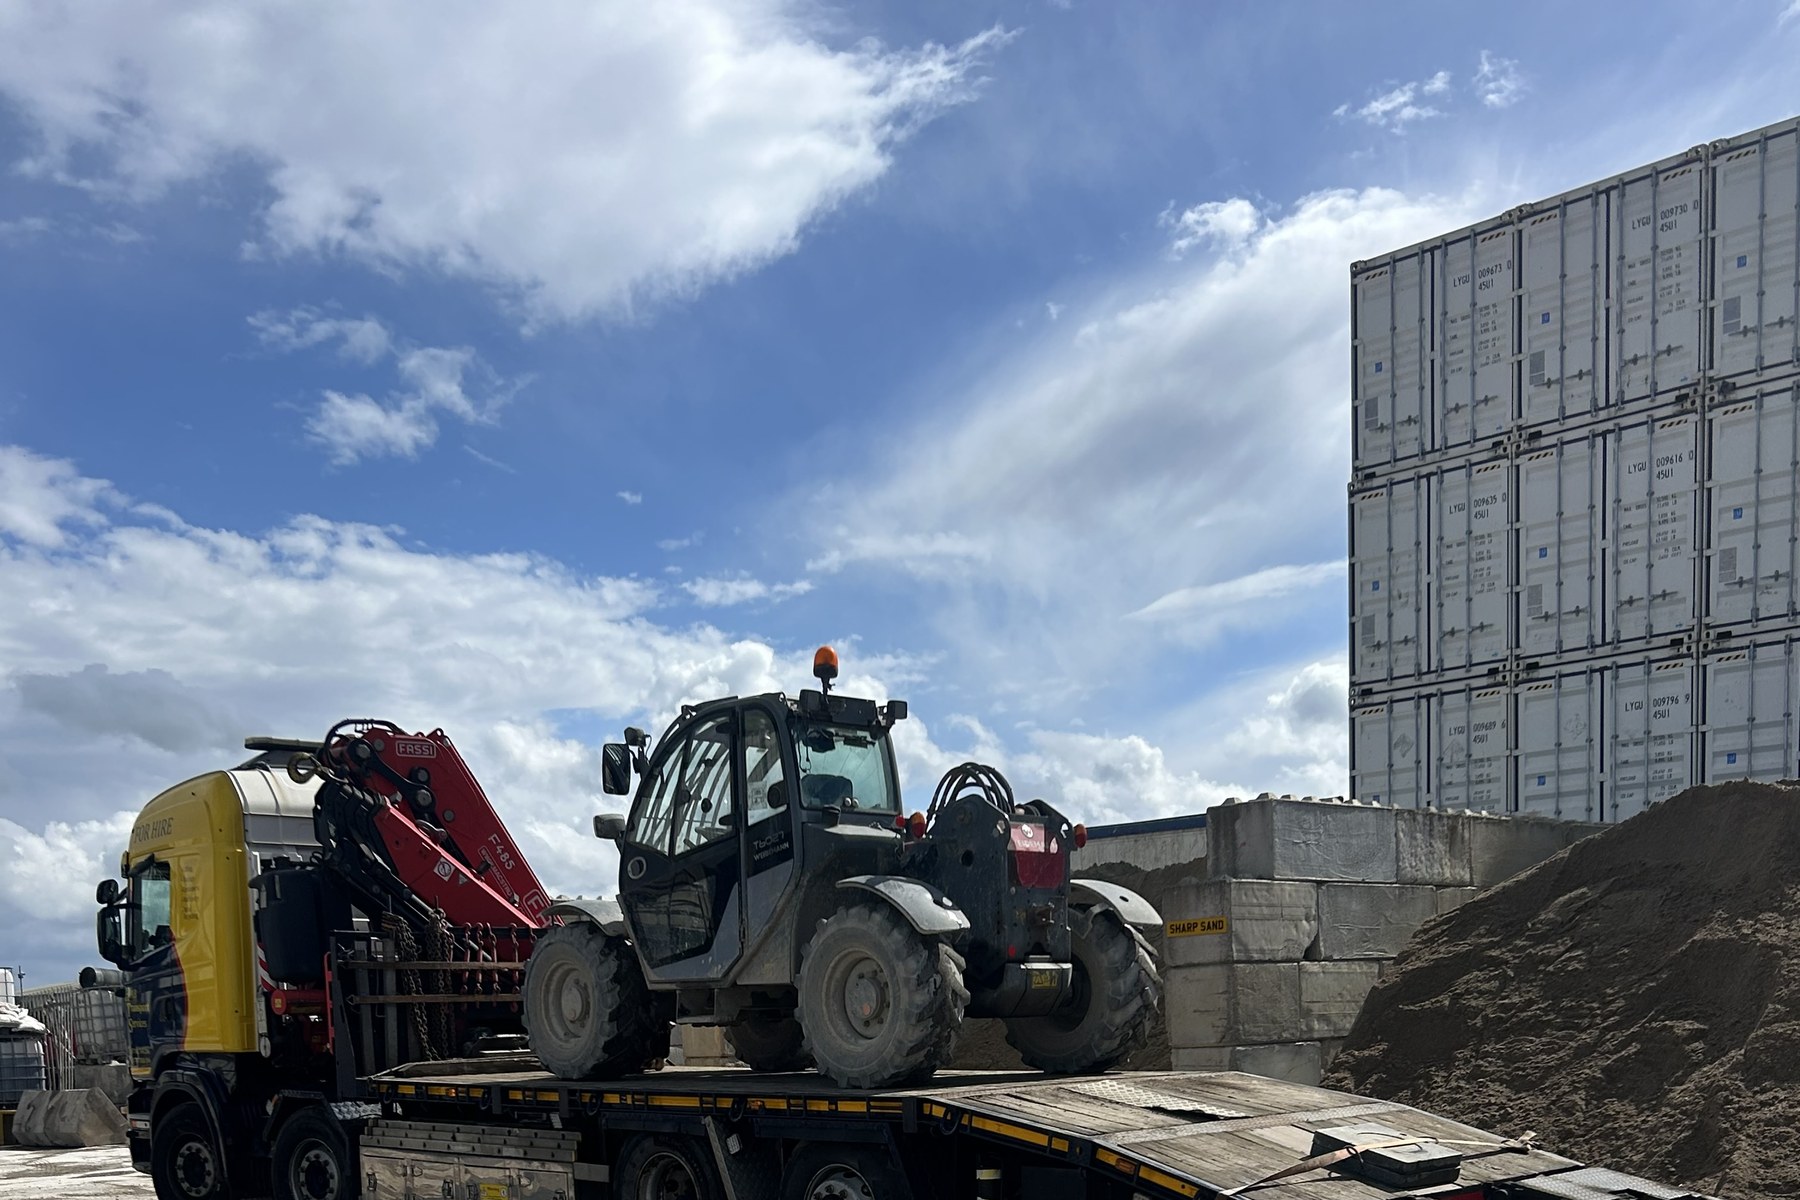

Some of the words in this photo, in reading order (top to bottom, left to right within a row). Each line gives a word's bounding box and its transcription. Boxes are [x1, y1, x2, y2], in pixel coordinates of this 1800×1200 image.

[1631, 214, 1651, 230] LYGU
[1660, 203, 1688, 221] 009730
[1693, 199, 1699, 210] 0
[1659, 219, 1678, 233] 45U1
[1453, 273, 1470, 288] LYGU
[1478, 263, 1503, 280] 009673
[1507, 259, 1512, 271] 0
[1478, 278, 1494, 292] 45U1
[1628, 461, 1647, 475] LYGU
[1656, 452, 1683, 468] 009616
[1688, 449, 1694, 461] 0
[1656, 467, 1674, 480] 45U1
[1449, 502, 1466, 515] LYGU
[1473, 494, 1497, 508] 009635
[1501, 491, 1507, 503] 0
[1473, 508, 1489, 520] 45U1
[1625, 700, 1644, 712] LYGU
[1652, 695, 1679, 708] 009796
[1684, 693, 1690, 705] 9
[1652, 709, 1670, 720] 45U1
[399, 742, 434, 757] FASSI
[134, 824, 149, 843] FOR
[150, 816, 174, 840] HIRE
[1169, 921, 1199, 934] SHARP
[1200, 919, 1224, 932] SAND
